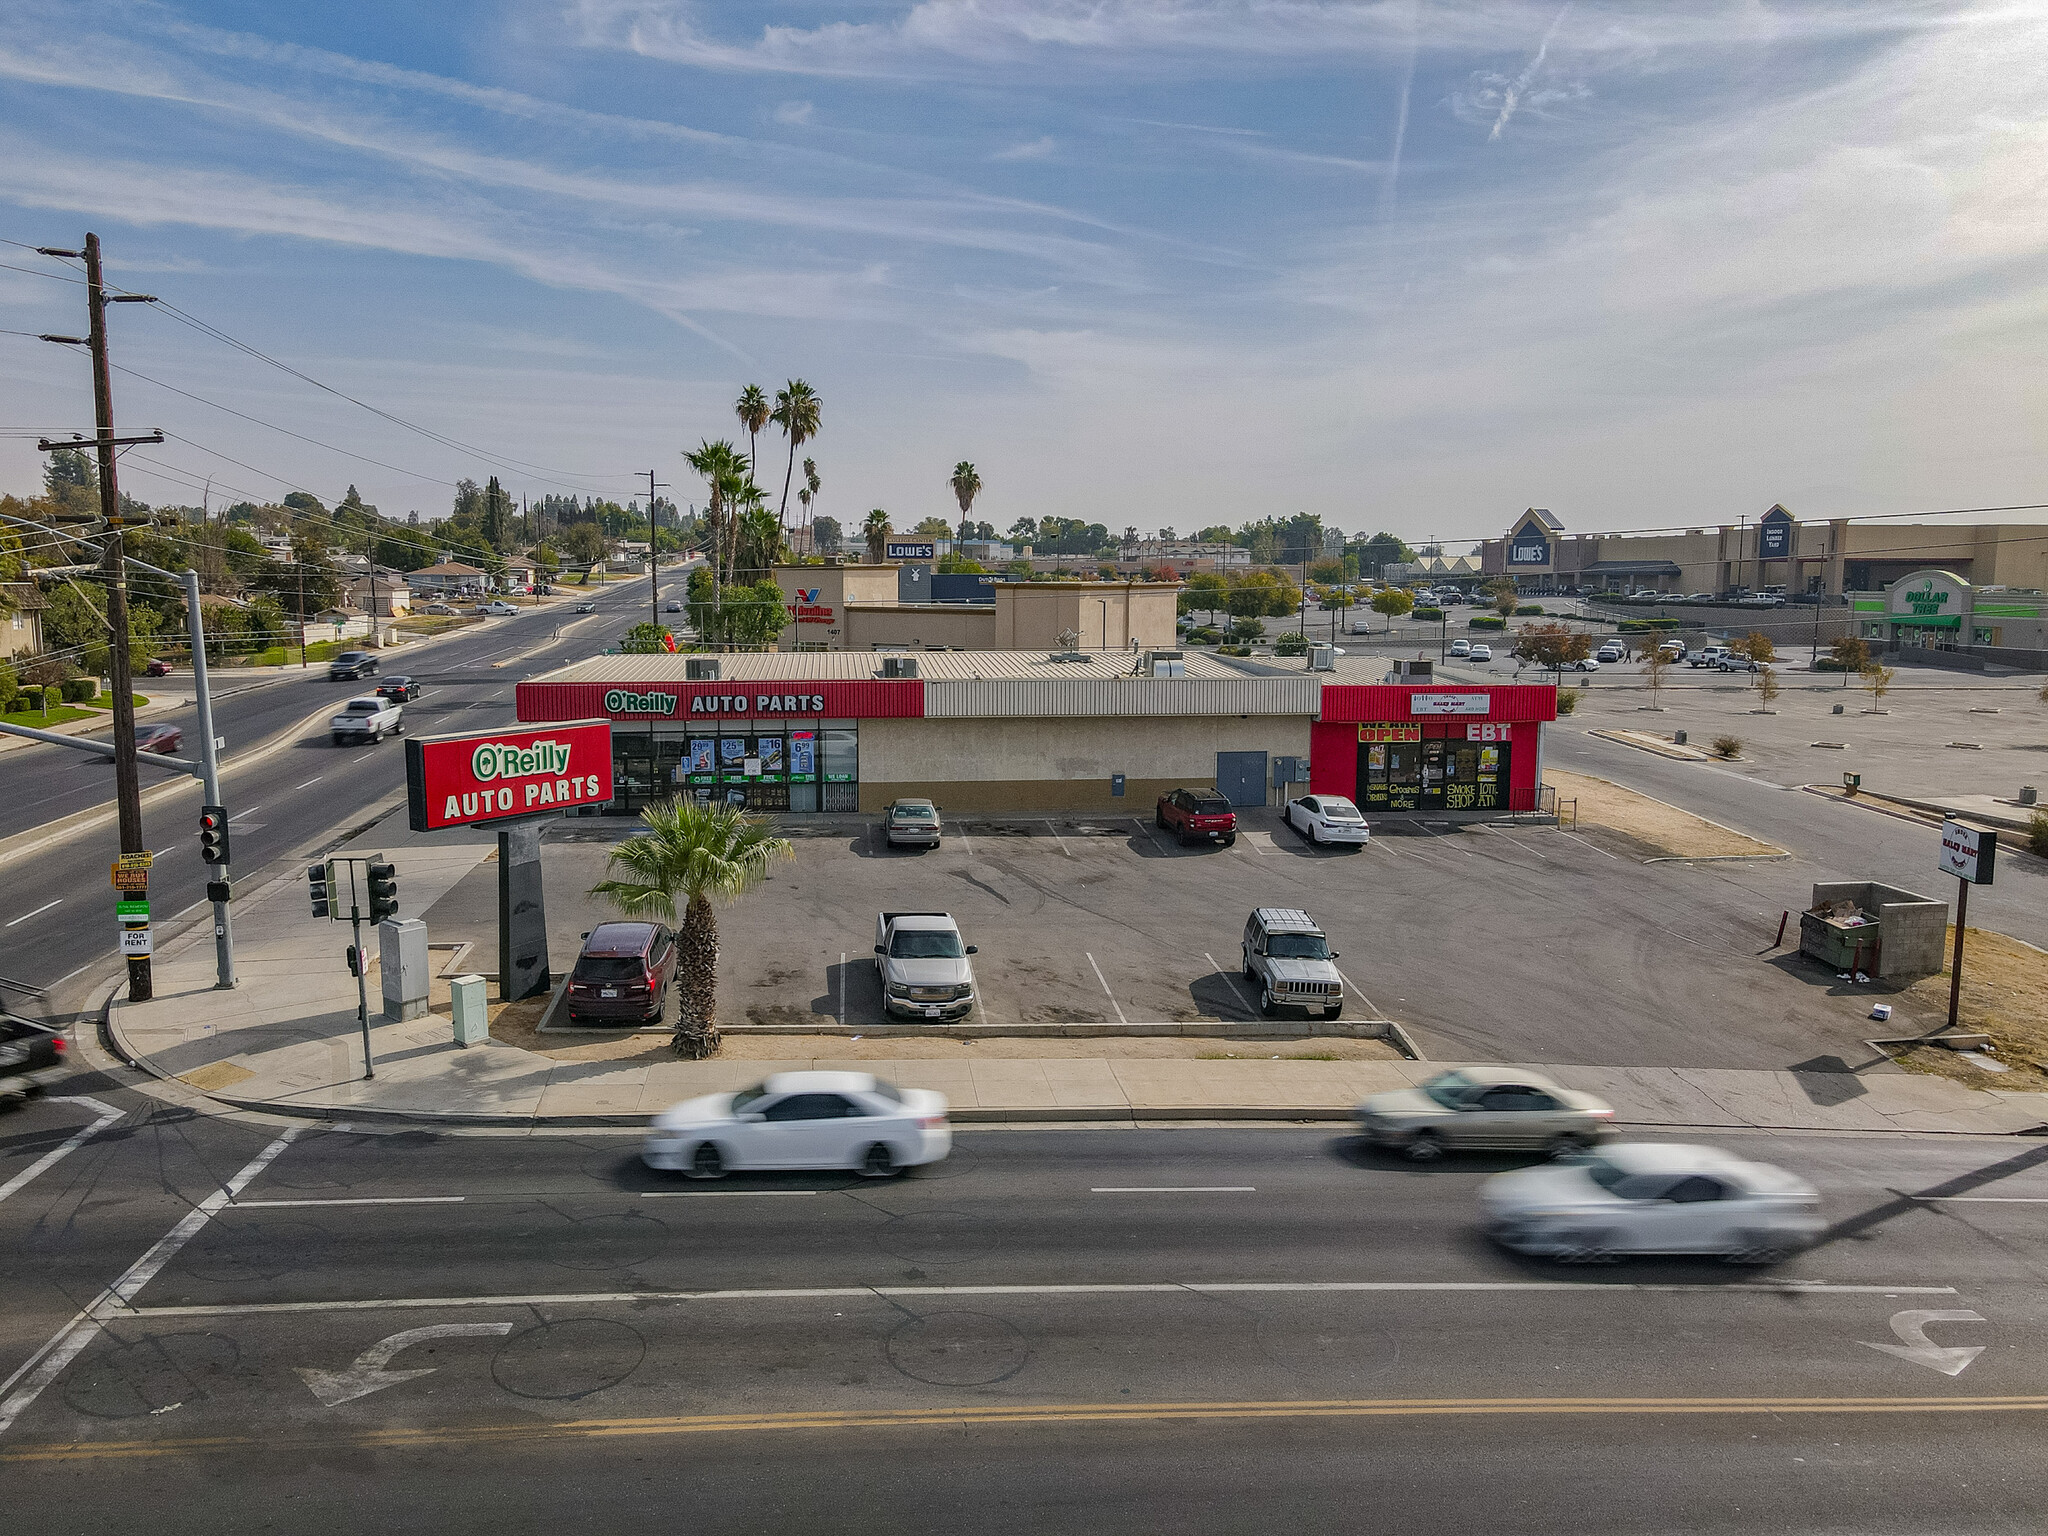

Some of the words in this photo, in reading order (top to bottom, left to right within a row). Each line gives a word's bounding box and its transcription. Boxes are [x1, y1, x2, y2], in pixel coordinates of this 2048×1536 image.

[889, 544, 932, 557] LOWE'S
[1513, 544, 1543, 561] LOWE'S
[1905, 591, 1949, 603] DOLLAR
[1912, 604, 1939, 614] TREE
[605, 690, 676, 715] O'Reilly
[692, 696, 748, 712] AUTO
[757, 695, 824, 711] PARTS
[1360, 729, 1420, 741] OPEN
[1467, 723, 1511, 741] EBT
[473, 741, 570, 780] O'Reilly
[1447, 783, 1475, 795] SMOKE
[444, 787, 513, 819] AUTO
[525, 775, 600, 807] PARTS
[1446, 795, 1475, 808] SHOP
[1390, 800, 1415, 808] MORE
